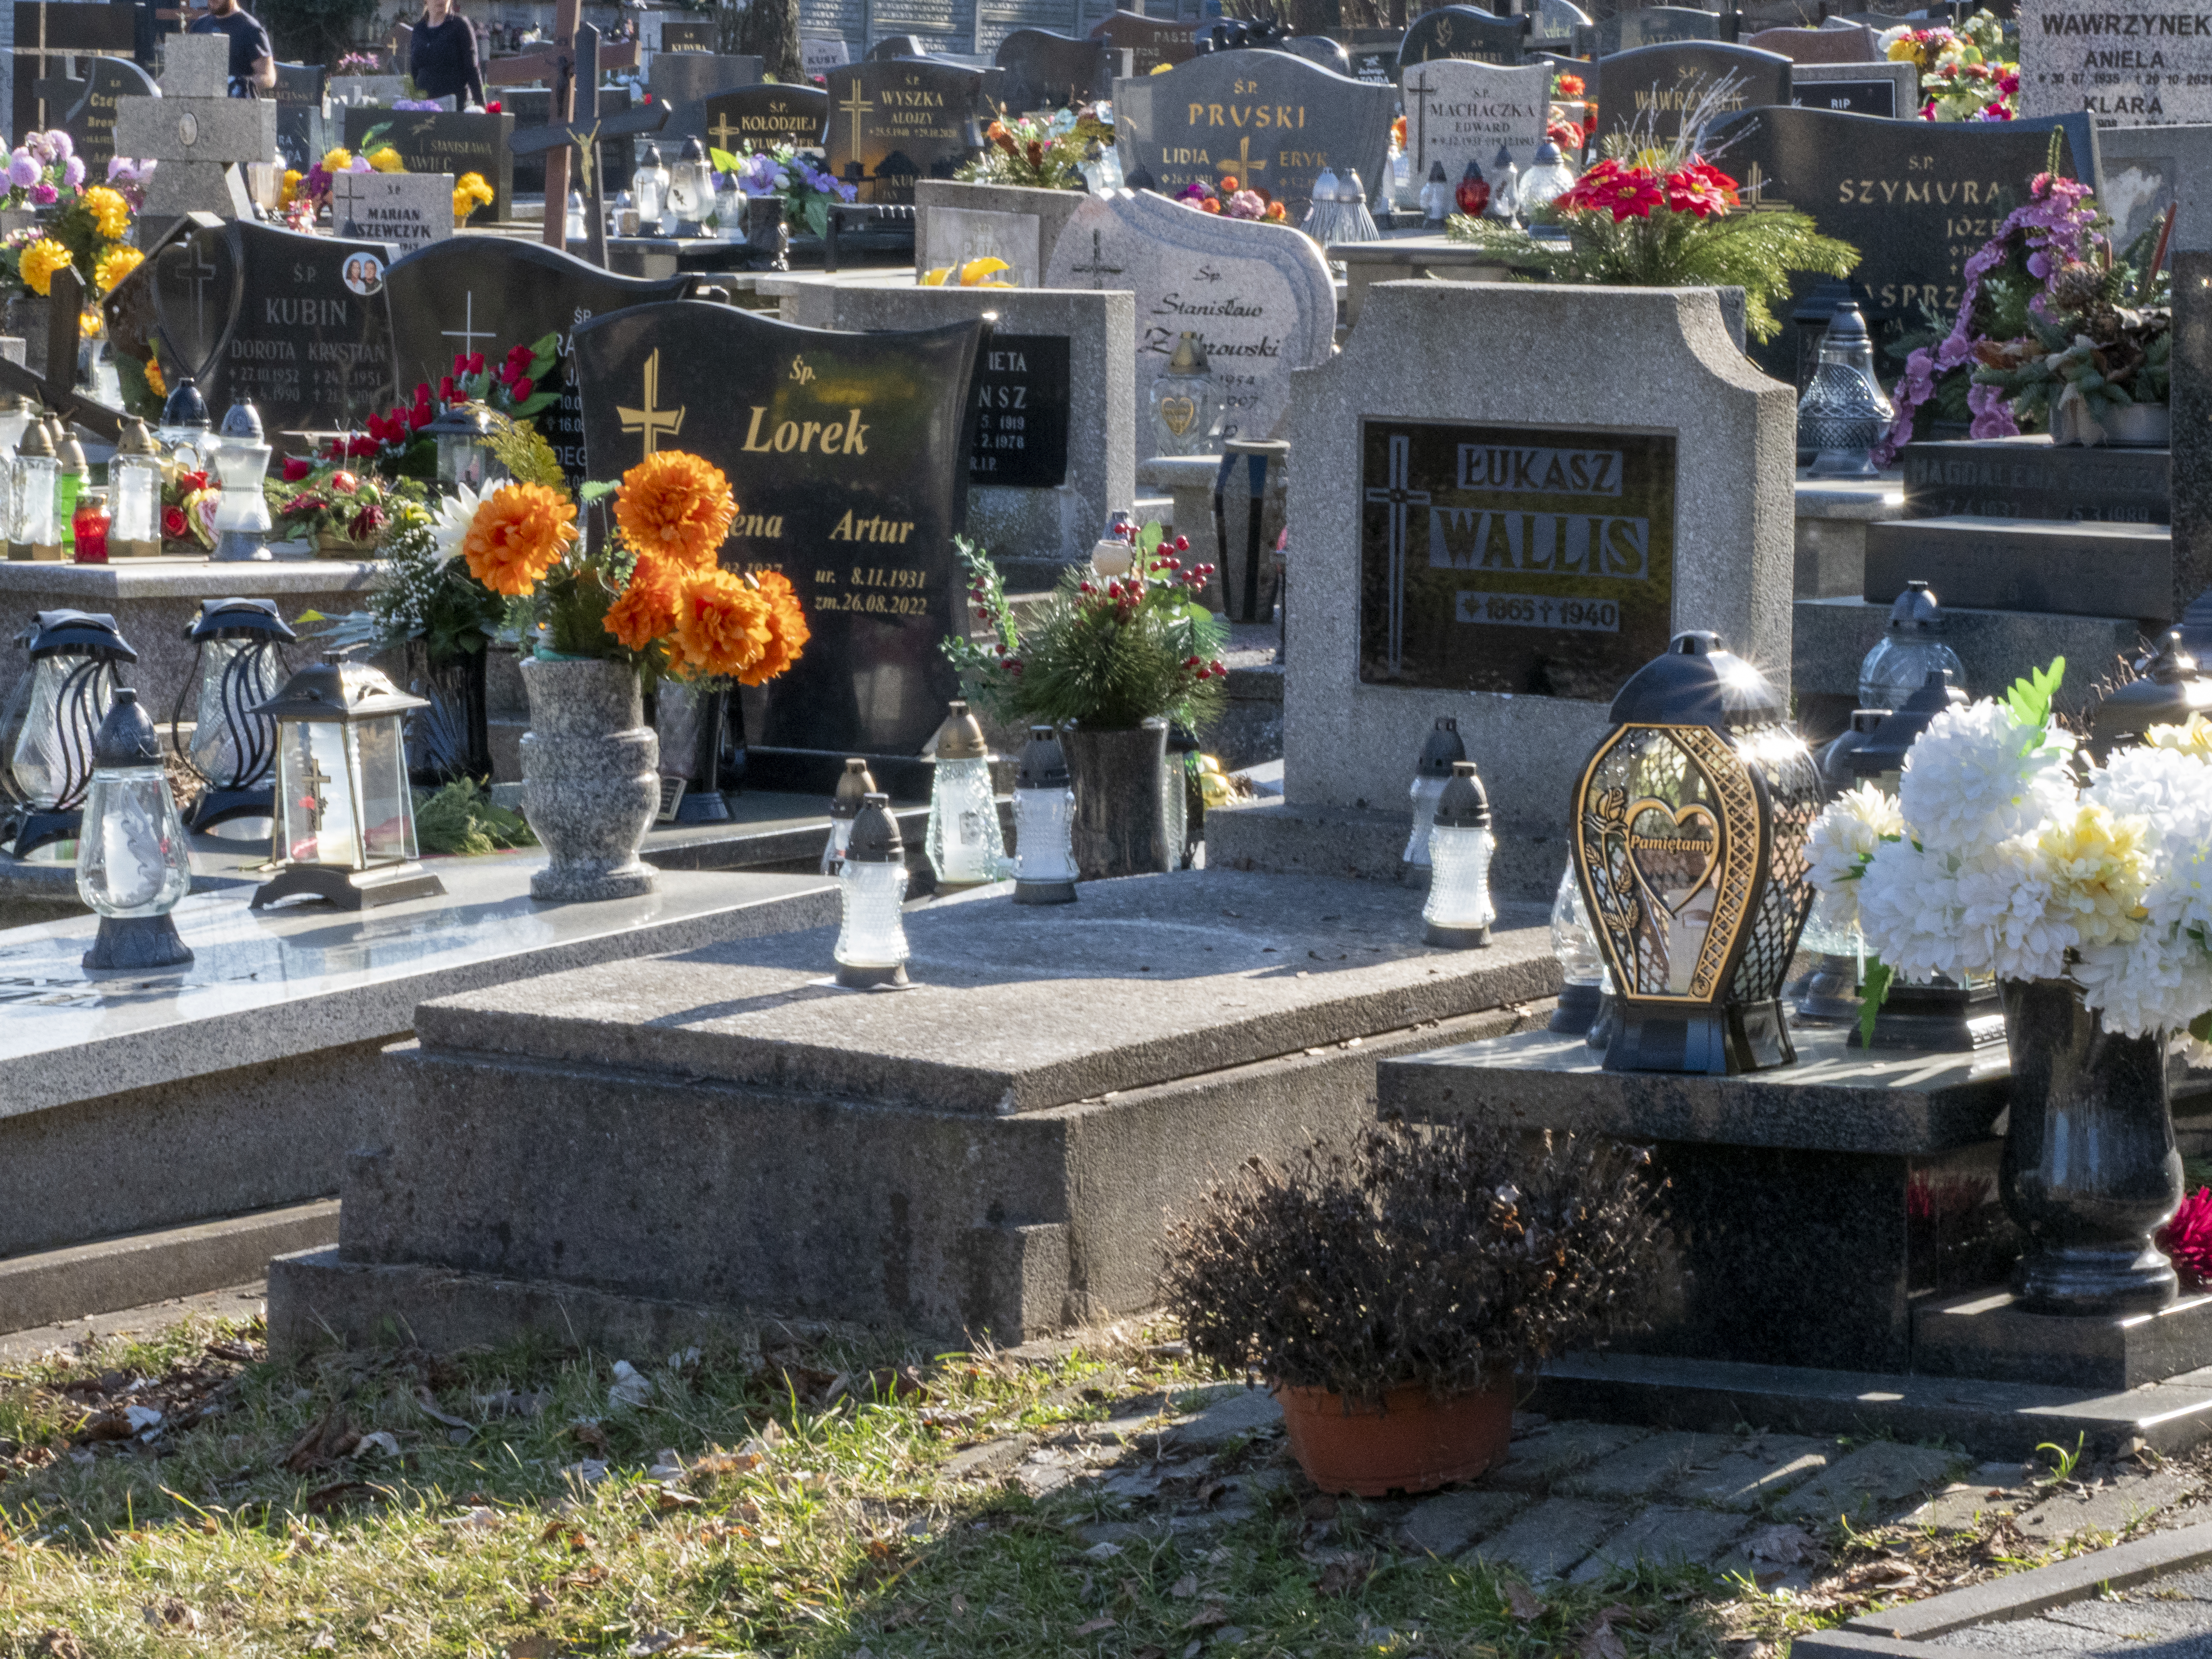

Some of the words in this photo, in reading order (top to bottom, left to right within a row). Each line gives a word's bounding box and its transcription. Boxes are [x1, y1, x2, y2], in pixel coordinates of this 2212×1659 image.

[2042, 13, 2212, 36] WAWRZYNEK
[2084, 50, 2165, 68] ANIELA
[882, 91, 944, 107] WYSZKA
[1431, 103, 1535, 117] MACHACZKA
[1635, 90, 1743, 112] WAWRZYEK
[1831, 97, 1851, 110] RIP
[2083, 95, 2164, 115] KLARA
[741, 116, 817, 131] KOŁODZIEJ
[1455, 122, 1511, 133] EDWARD
[1162, 147, 1210, 165] LIDIA
[1279, 151, 1328, 167] ERYK
[368, 208, 421, 221] MARIAN
[1947, 214, 2002, 238] JÓZE
[1152, 292, 1263, 317] Stanisław
[1864, 283, 1959, 309] SPRZ
[265, 298, 348, 326] KUBIN
[231, 339, 296, 360] DOROTA
[308, 341, 386, 363] KRYSTIAN
[989, 352, 1027, 372] IETA
[789, 355, 817, 384] Śp.
[978, 384, 1027, 409] NSZ
[741, 405, 871, 455] Lorek
[1464, 447, 1615, 493] ŁUKASZ
[730, 514, 784, 539] ena
[828, 508, 914, 544] Artur
[1437, 510, 1643, 577] WALLIS
[815, 569, 836, 584] ur.
[851, 566, 926, 589] 8.11.1931
[1559, 600, 1616, 628] 1940
[1630, 835, 1714, 854] Pamiętamy
